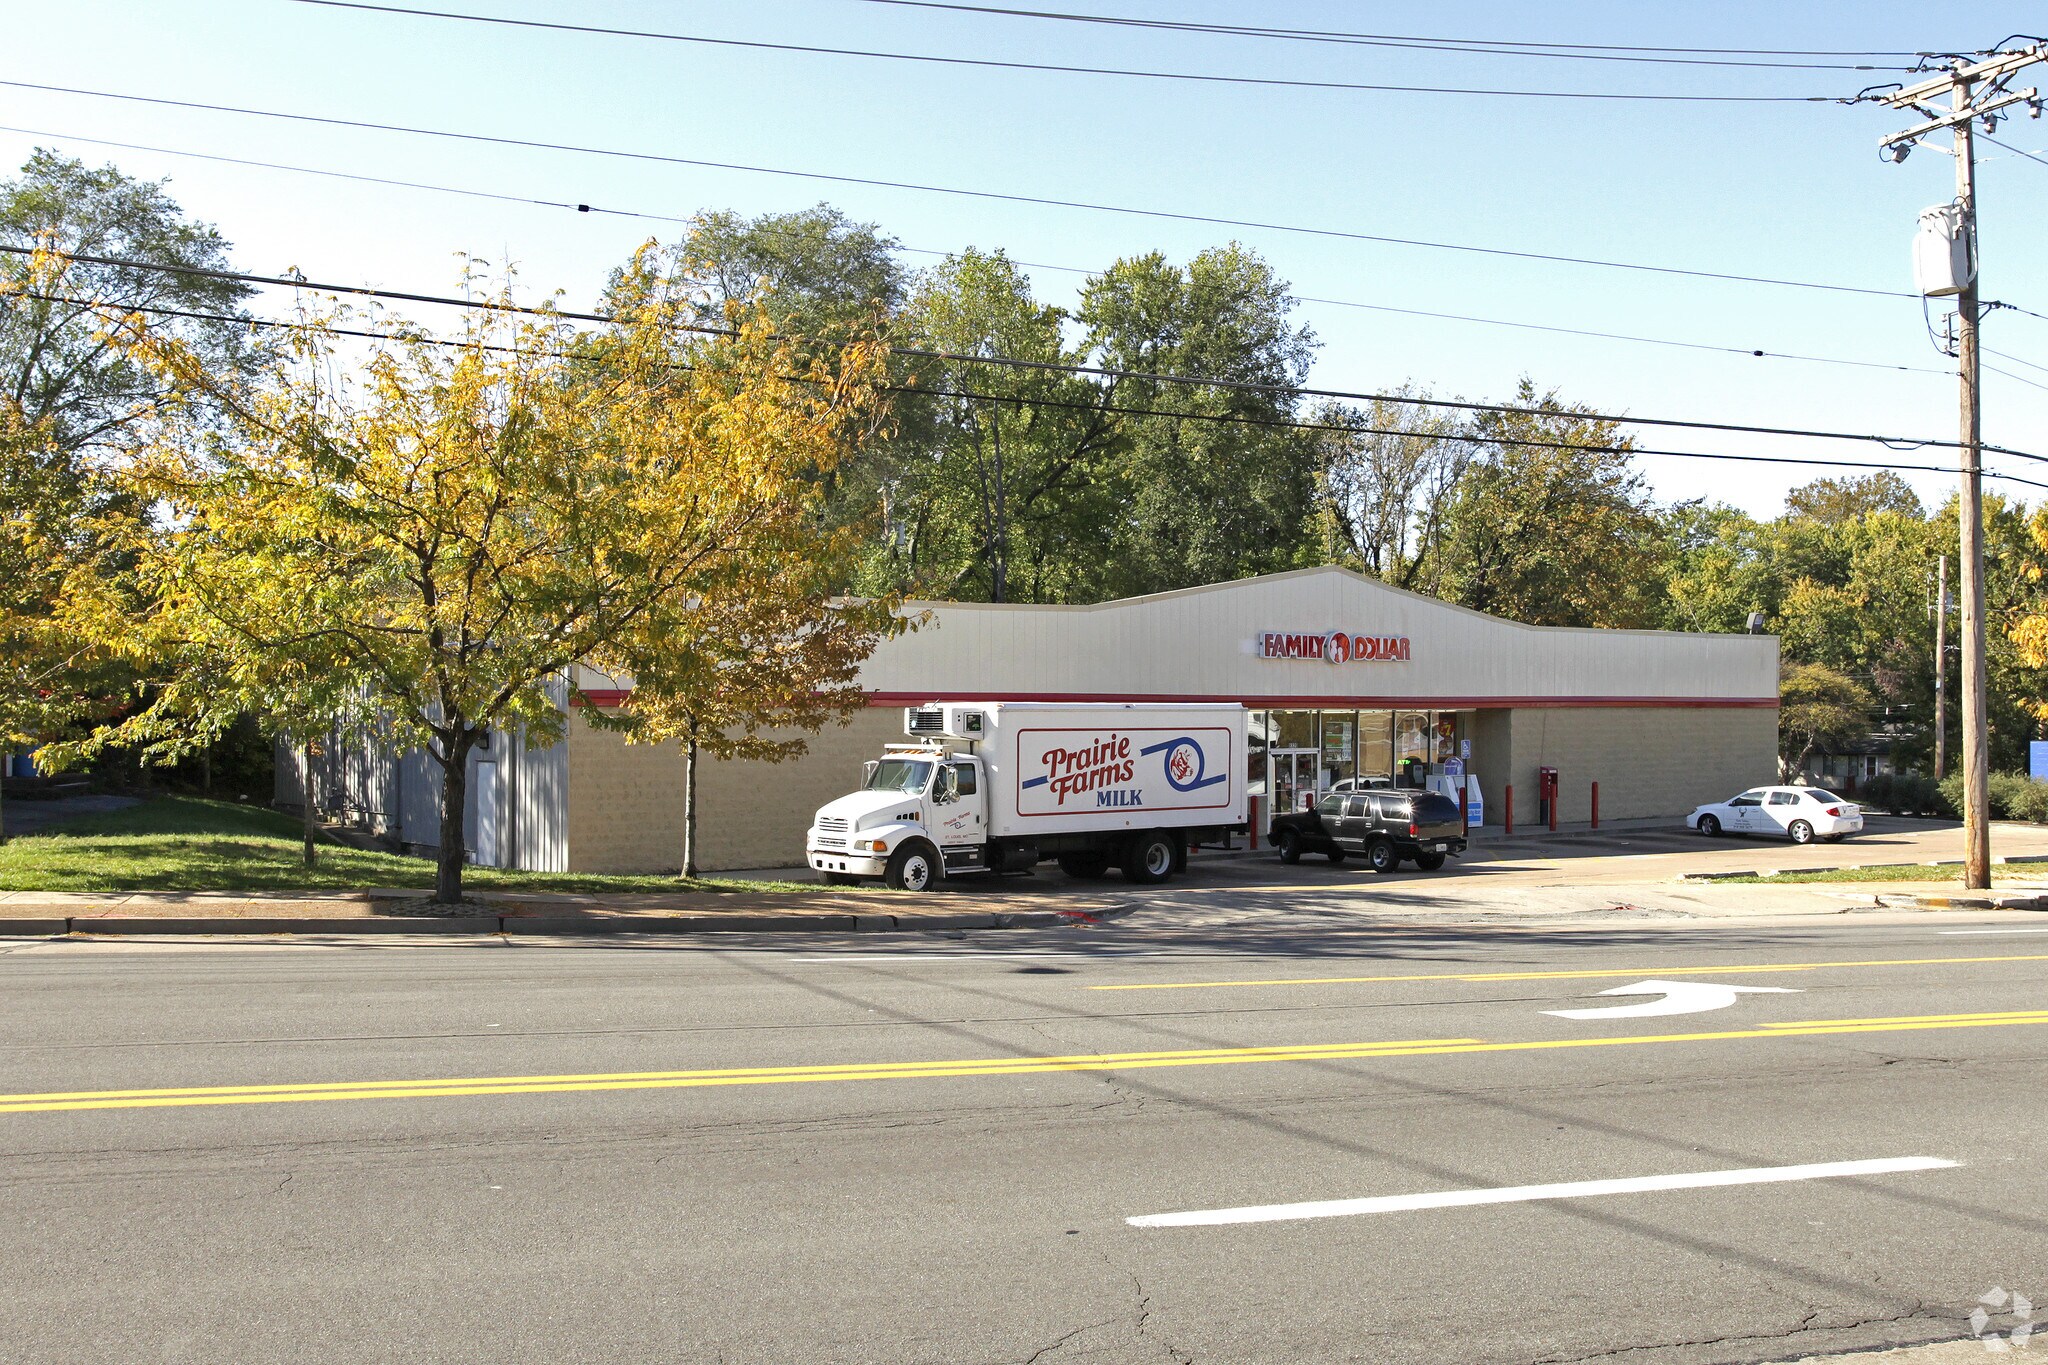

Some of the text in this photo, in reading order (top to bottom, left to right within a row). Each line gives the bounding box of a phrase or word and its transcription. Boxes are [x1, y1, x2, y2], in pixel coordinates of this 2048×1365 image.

[1264, 632, 1411, 661] FAMILY DOLLAR
[1042, 733, 1131, 778] Prairie
[1050, 759, 1135, 806] Farms
[1097, 789, 1143, 807] MILK
